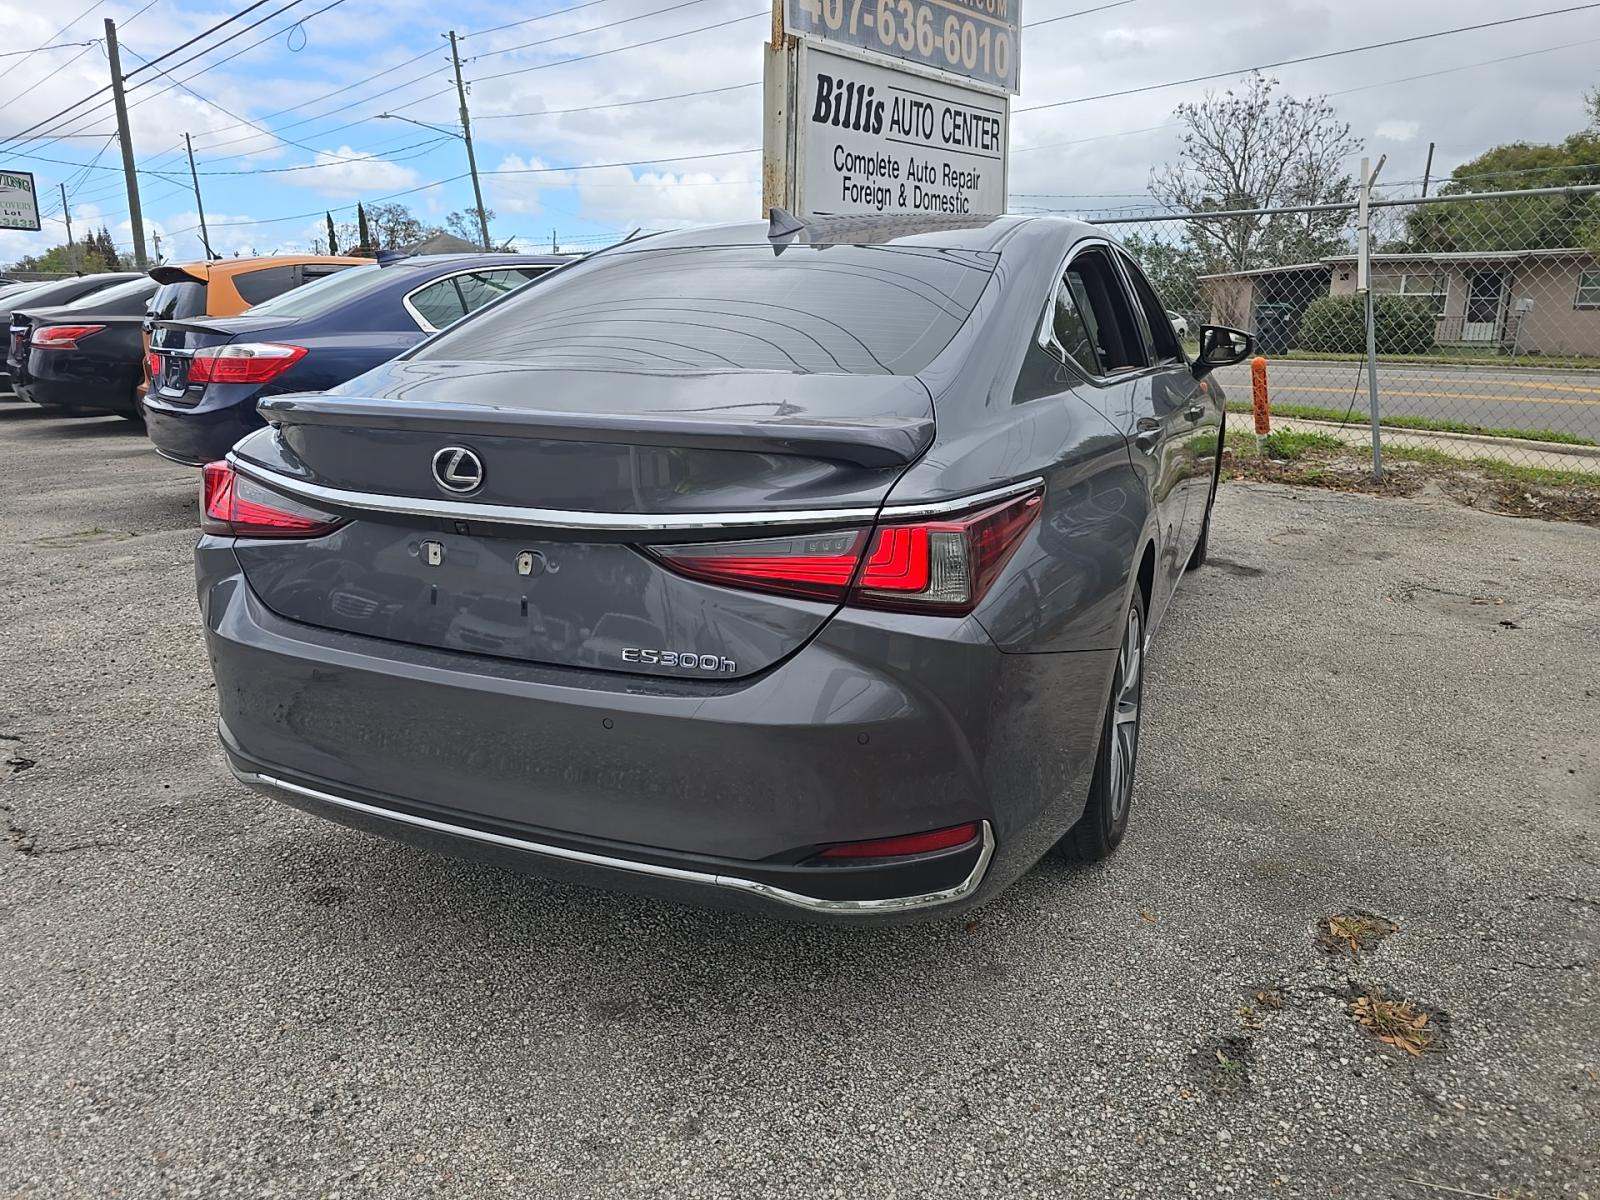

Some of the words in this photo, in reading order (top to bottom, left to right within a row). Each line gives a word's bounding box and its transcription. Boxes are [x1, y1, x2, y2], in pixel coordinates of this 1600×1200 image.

[812, 73, 885, 135] Billis
[889, 96, 934, 140] AUTO
[941, 107, 1000, 152] CENTER
[833, 144, 900, 180] Complete
[906, 157, 937, 185] Auto
[942, 163, 981, 193] Repair
[842, 176, 892, 211] Foreign
[897, 182, 907, 208] &
[913, 185, 970, 214] Domestic
[621, 647, 737, 673] ES300h
